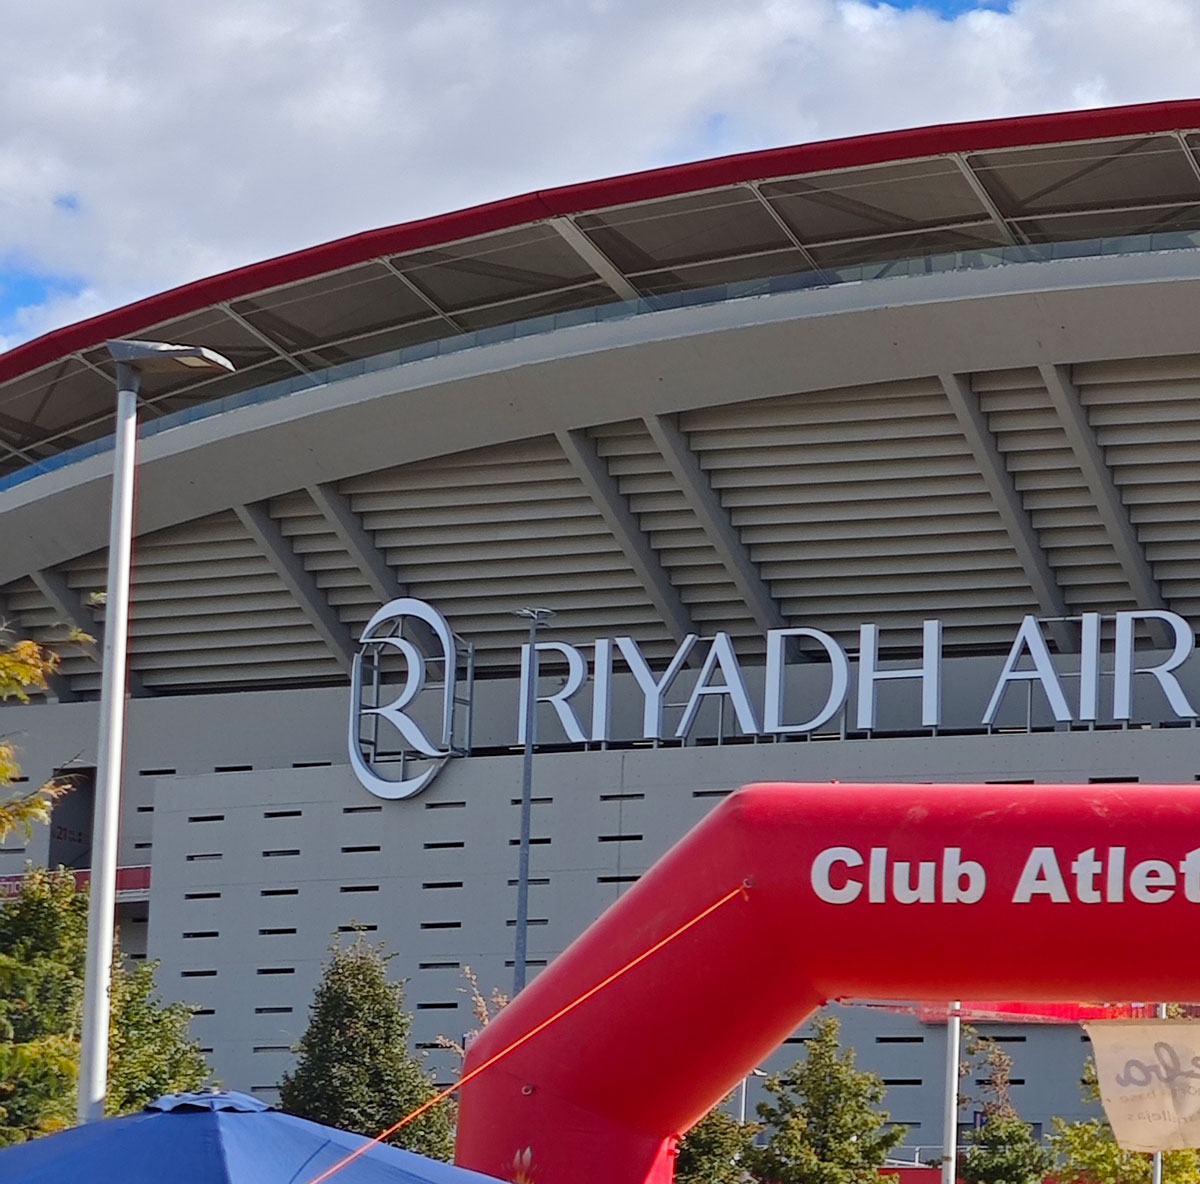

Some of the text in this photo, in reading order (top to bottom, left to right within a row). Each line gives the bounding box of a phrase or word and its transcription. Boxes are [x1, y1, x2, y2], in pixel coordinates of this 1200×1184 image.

[516, 618, 942, 746] RIYADH
[982, 609, 1200, 727] AIR
[810, 845, 988, 906] Club
